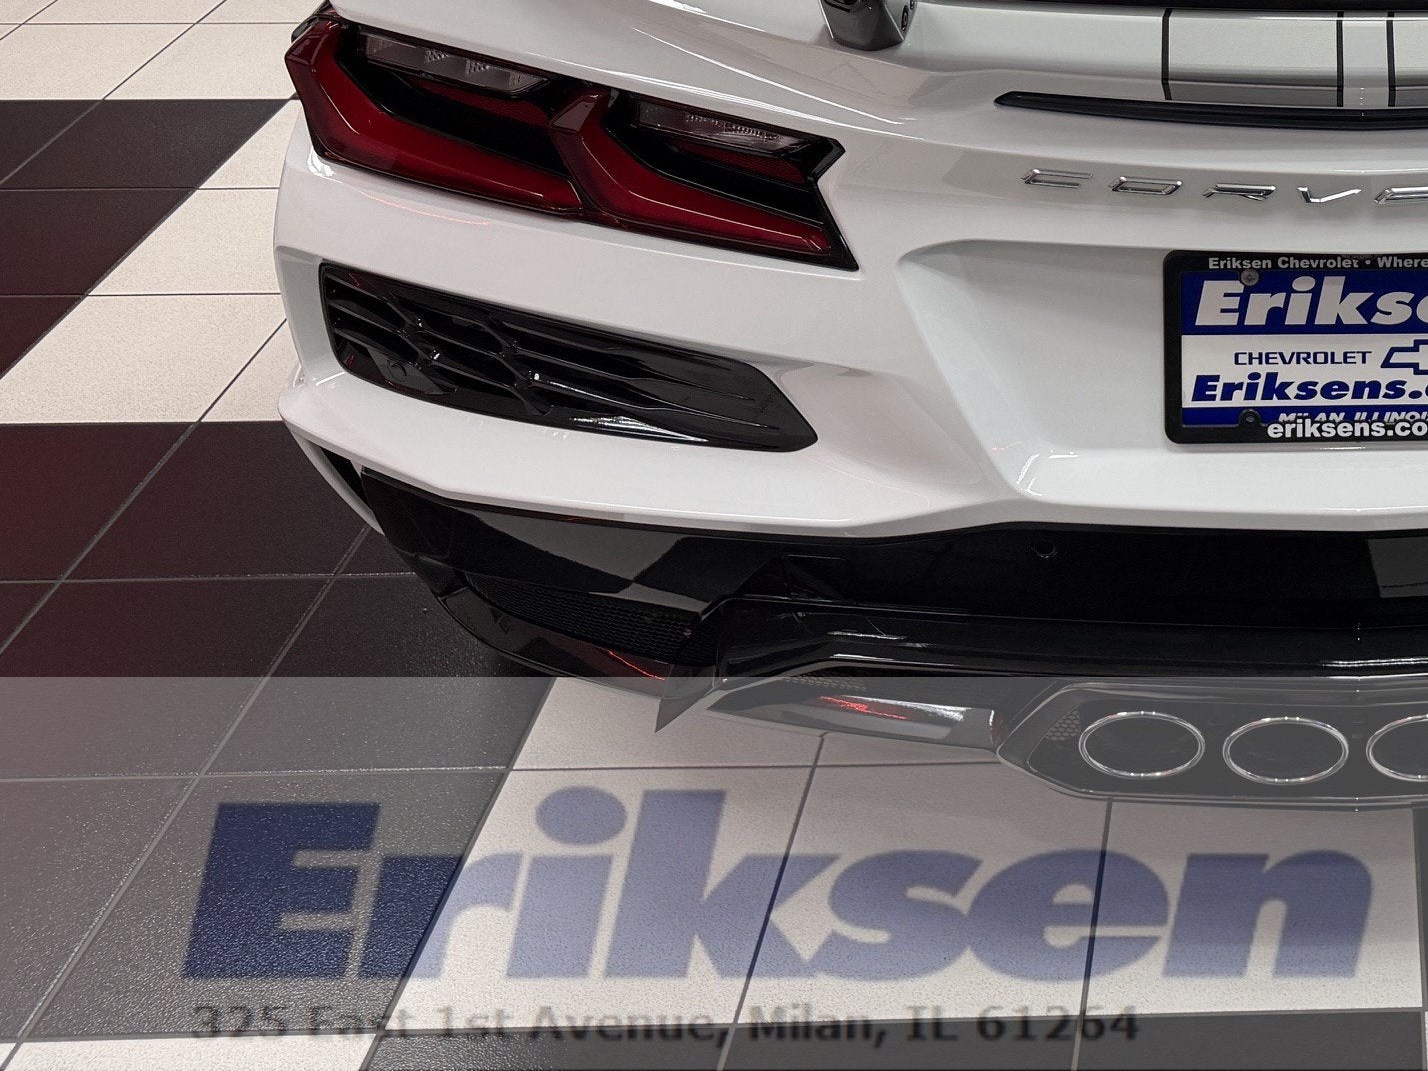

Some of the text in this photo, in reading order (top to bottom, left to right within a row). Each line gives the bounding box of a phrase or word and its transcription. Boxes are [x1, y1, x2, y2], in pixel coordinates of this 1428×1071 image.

[1208, 256, 1272, 269] Eriksen
[1277, 256, 1359, 269] Chevrolet
[1234, 351, 1372, 366] CHEVROLET
[1278, 412, 1345, 423] MAN
